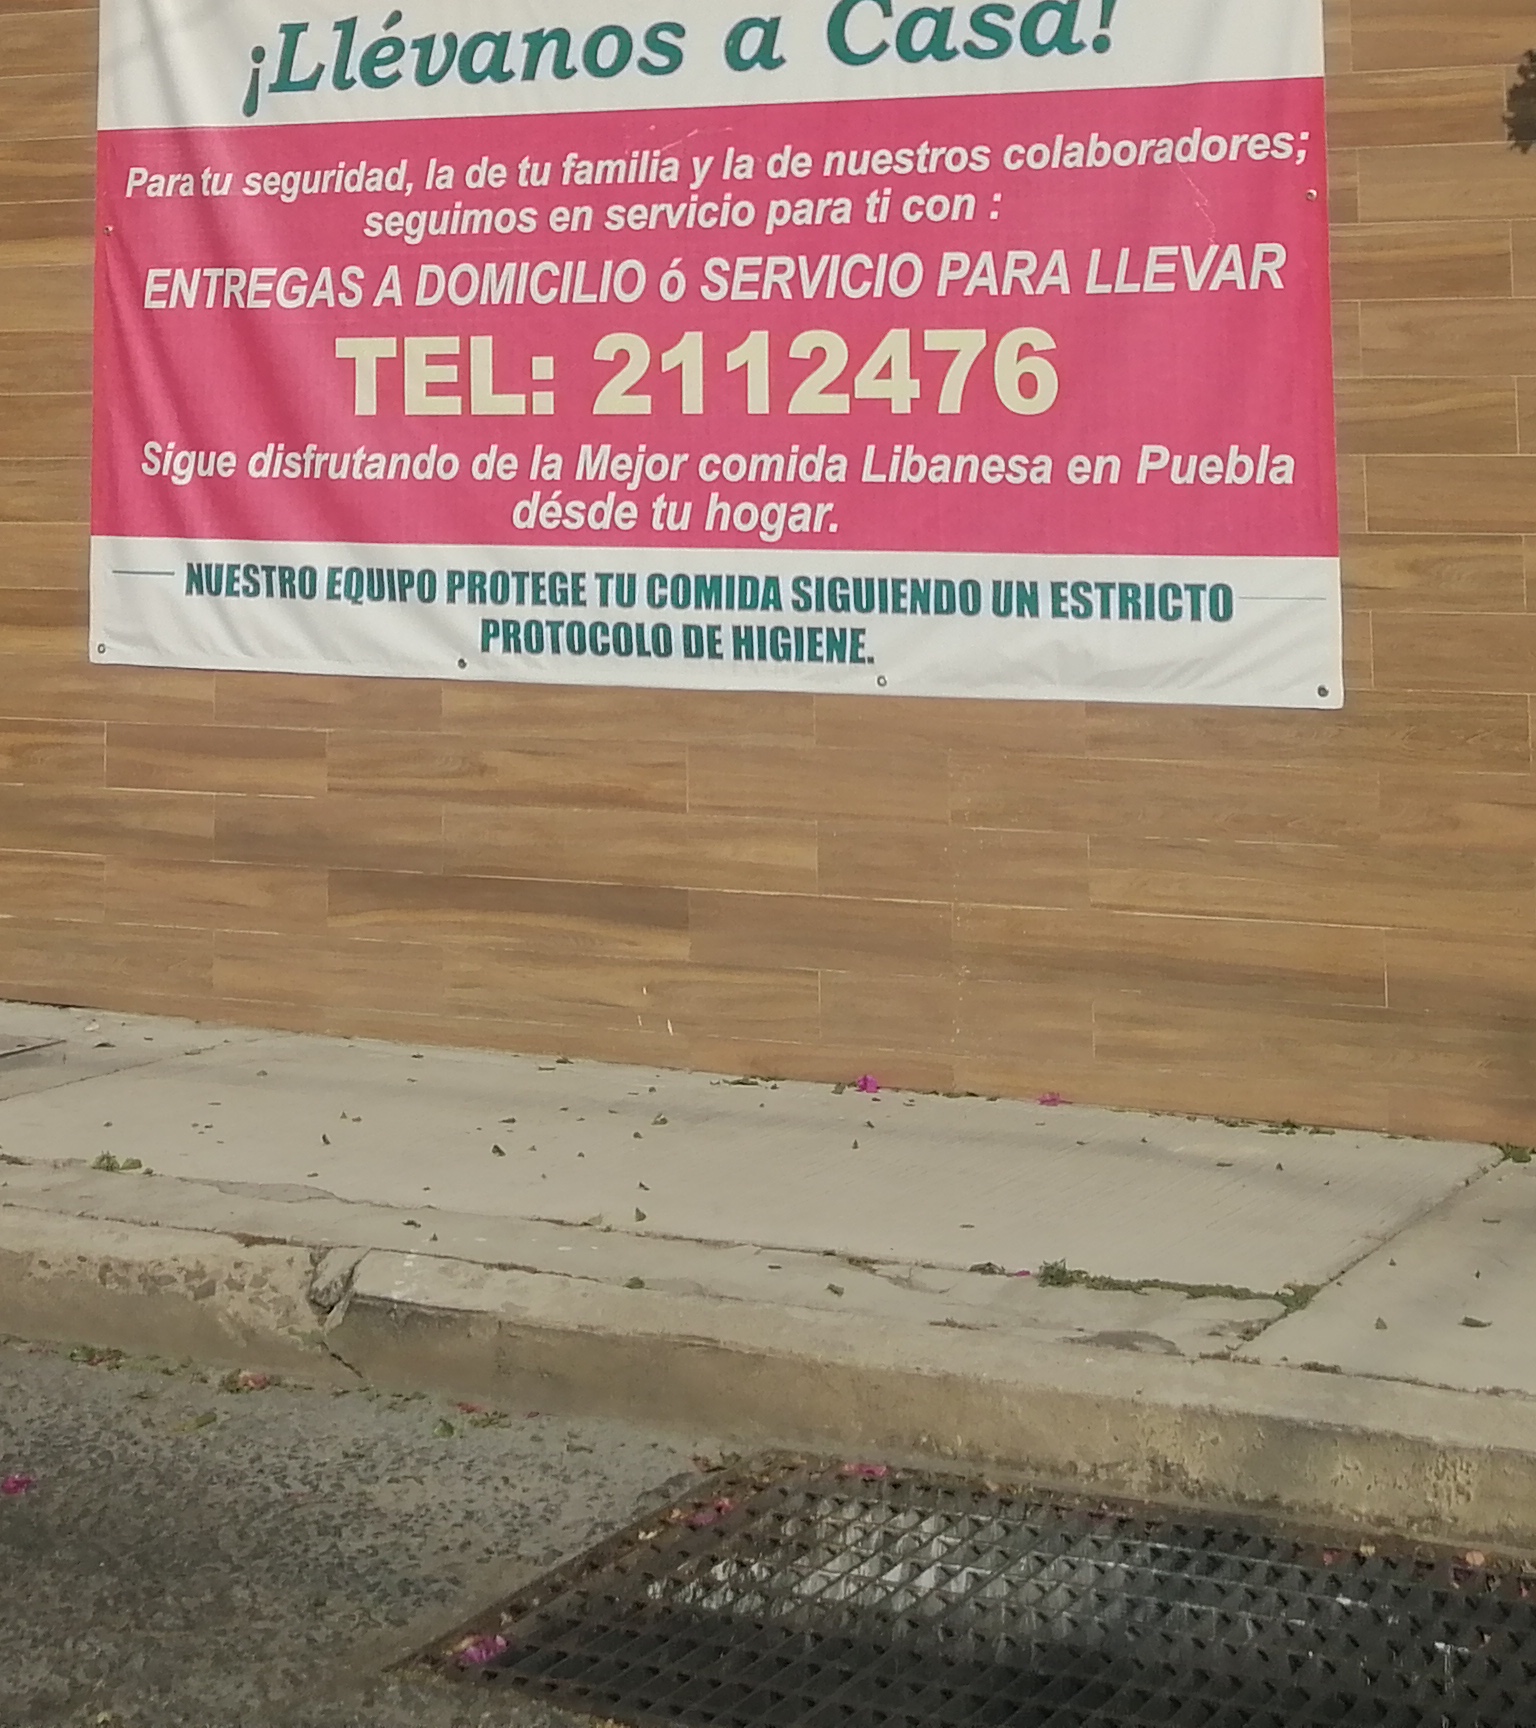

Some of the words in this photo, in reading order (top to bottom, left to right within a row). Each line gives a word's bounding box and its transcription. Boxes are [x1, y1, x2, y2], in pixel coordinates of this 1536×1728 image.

[242, 10, 686, 117] ¡Llévanos
[724, 12, 787, 72] a
[125, 166, 195, 198] Para
[201, 167, 232, 196] tu
[243, 160, 413, 203] seguridad,
[426, 158, 454, 189] la
[465, 156, 507, 189] de
[518, 156, 551, 187] tu
[562, 150, 679, 186] familia
[688, 154, 713, 190] y
[722, 147, 754, 180] la
[766, 145, 812, 179] de
[823, 140, 991, 177] nuestros
[1002, 127, 1309, 169] colaboradores;
[364, 202, 537, 244] seguimos
[549, 204, 592, 233] en
[604, 193, 755, 231] servicio
[765, 197, 851, 234] para
[865, 188, 890, 223] ti
[902, 190, 974, 222] con
[144, 265, 364, 308] ENTREGAS
[373, 264, 402, 307] A
[414, 259, 645, 306] DOMICILIO
[659, 257, 685, 302] ó
[701, 252, 923, 302] SERVICIO
[937, 249, 1070, 297] PARA
[1086, 242, 1285, 295] LLEVAR
[334, 334, 556, 417] TEL:
[592, 328, 1059, 417] 2112476
[142, 441, 236, 485] Sigue
[248, 442, 459, 480] disfrutando
[472, 444, 518, 479] de
[529, 444, 563, 481] la
[575, 444, 688, 490] Mejor
[698, 444, 846, 483] comida
[861, 445, 1053, 484] Libanesa
[1066, 454, 1120, 484] en
[1136, 444, 1295, 485] Puebla
[512, 491, 637, 530] désde
[651, 494, 691, 531] tu
[705, 494, 838, 542] hogar.
[185, 561, 317, 599] NUESTRO
[326, 566, 436, 605] EQUIPO
[446, 569, 587, 607] PROTEGE
[595, 573, 636, 608] TU
[646, 573, 782, 612] COMIDA
[792, 576, 981, 617] SIGUIENDO
[992, 580, 1038, 619] UN
[1050, 581, 1233, 622] ESTRICTO
[480, 617, 672, 658] PROTOCOLO
[683, 623, 723, 659] DE
[733, 625, 874, 664] HIGIENE.
